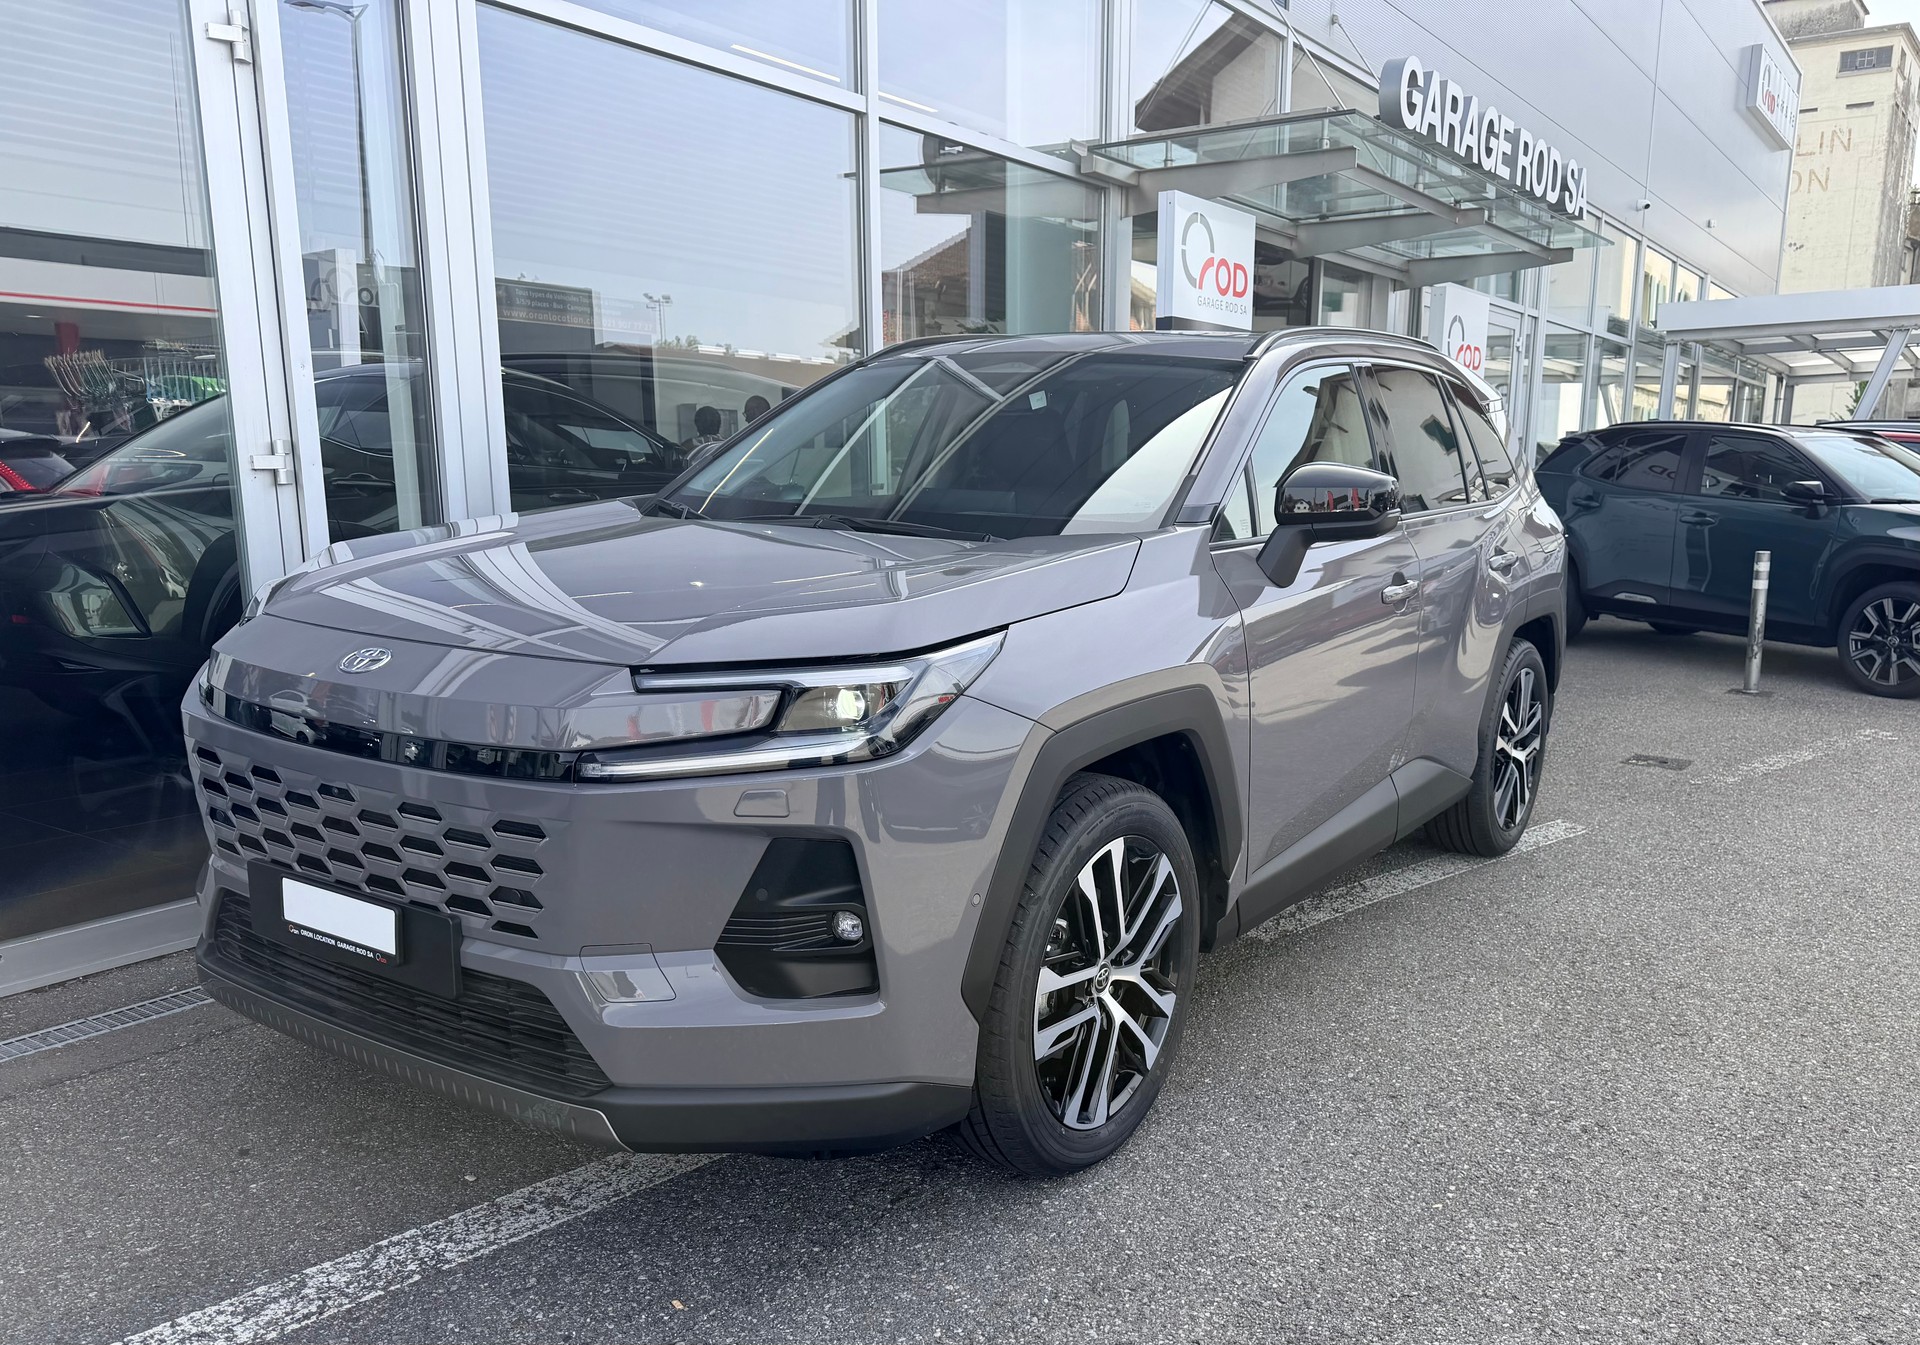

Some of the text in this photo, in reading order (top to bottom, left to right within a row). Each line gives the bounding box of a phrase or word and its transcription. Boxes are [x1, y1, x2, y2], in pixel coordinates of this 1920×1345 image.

[1399, 55, 1588, 221] GARAGE ROD SA
[1197, 295, 1248, 315] GARAGE ROD SA
[313, 933, 336, 946] LOCATION
[337, 941, 356, 953] GARAGE
[356, 947, 367, 956] ROD
[367, 950, 374, 959] SA
